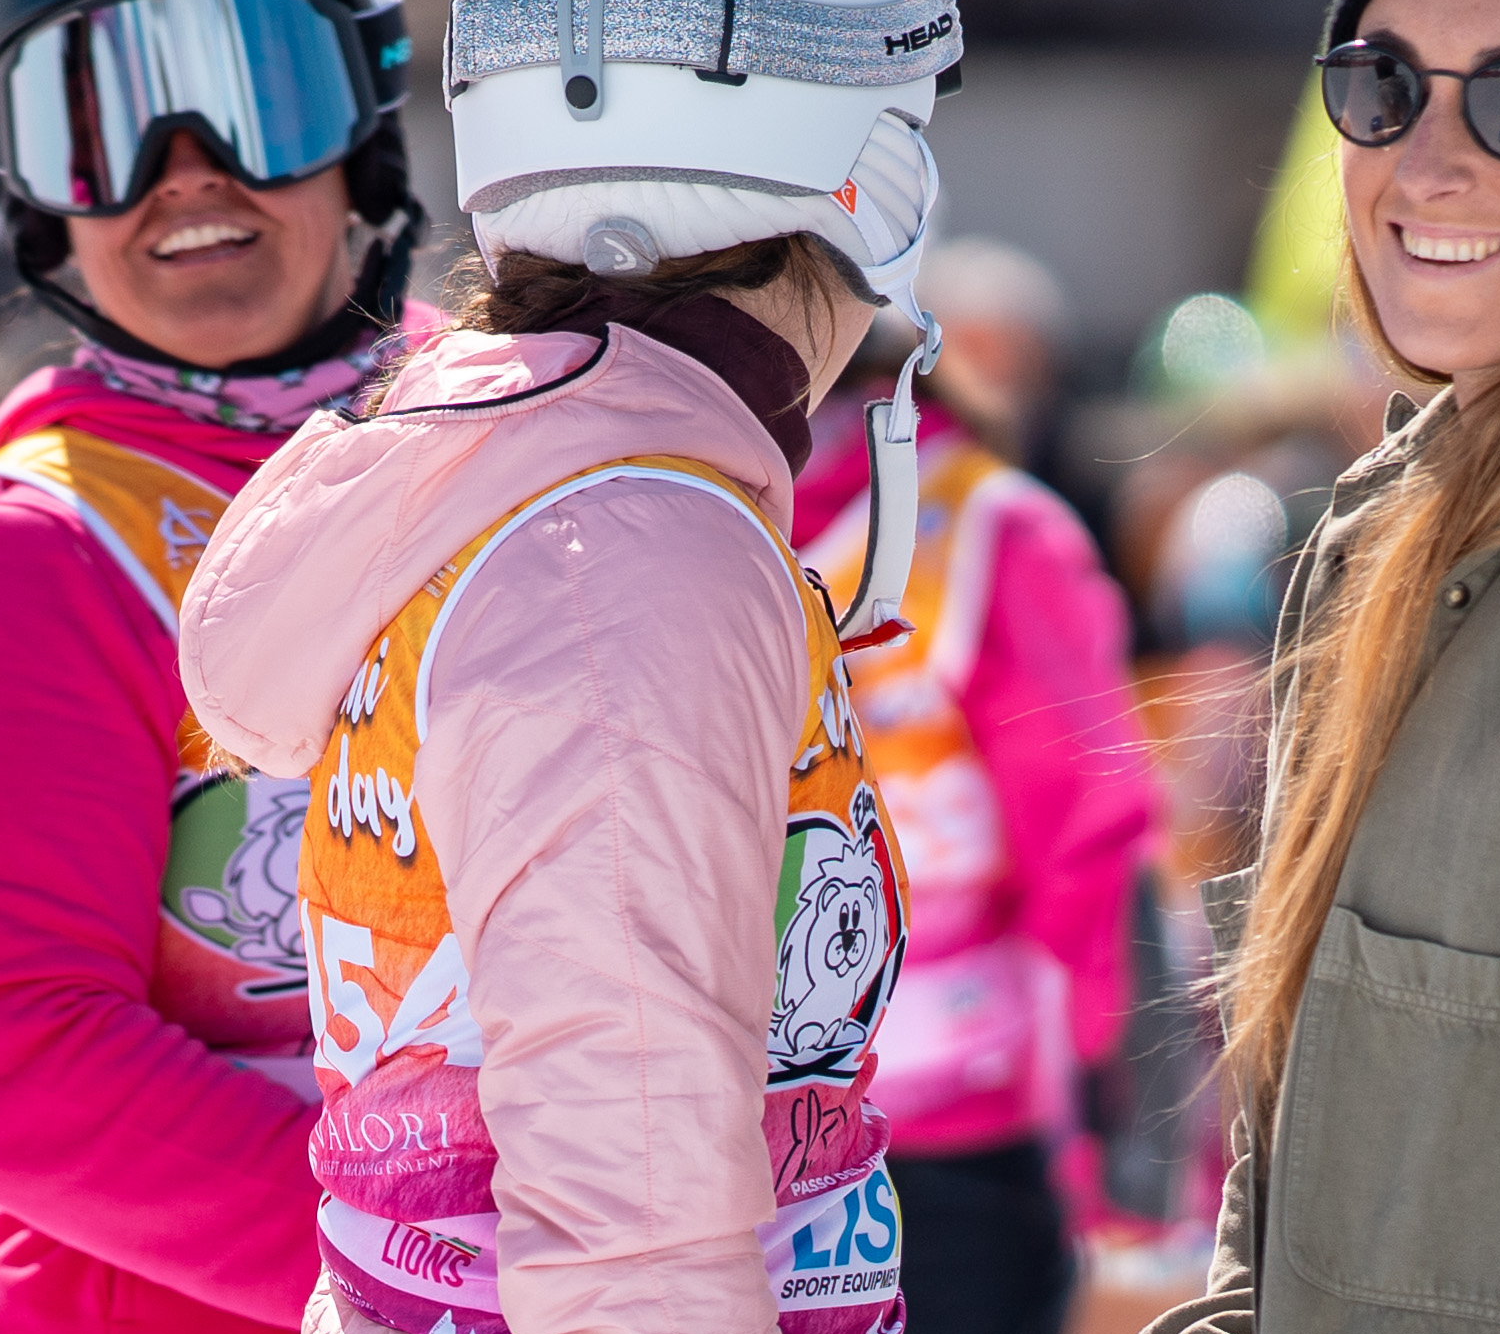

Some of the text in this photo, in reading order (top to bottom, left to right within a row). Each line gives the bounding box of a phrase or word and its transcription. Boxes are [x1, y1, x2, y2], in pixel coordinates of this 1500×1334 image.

[884, 13, 954, 57] HEAD
[327, 732, 415, 858] day
[341, 1153, 459, 1178] MANAGEMENT
[789, 1172, 836, 1198] PASSO
[791, 1169, 899, 1272] LIS
[381, 1221, 472, 1289] LIONS
[780, 1274, 840, 1300] SPORT
